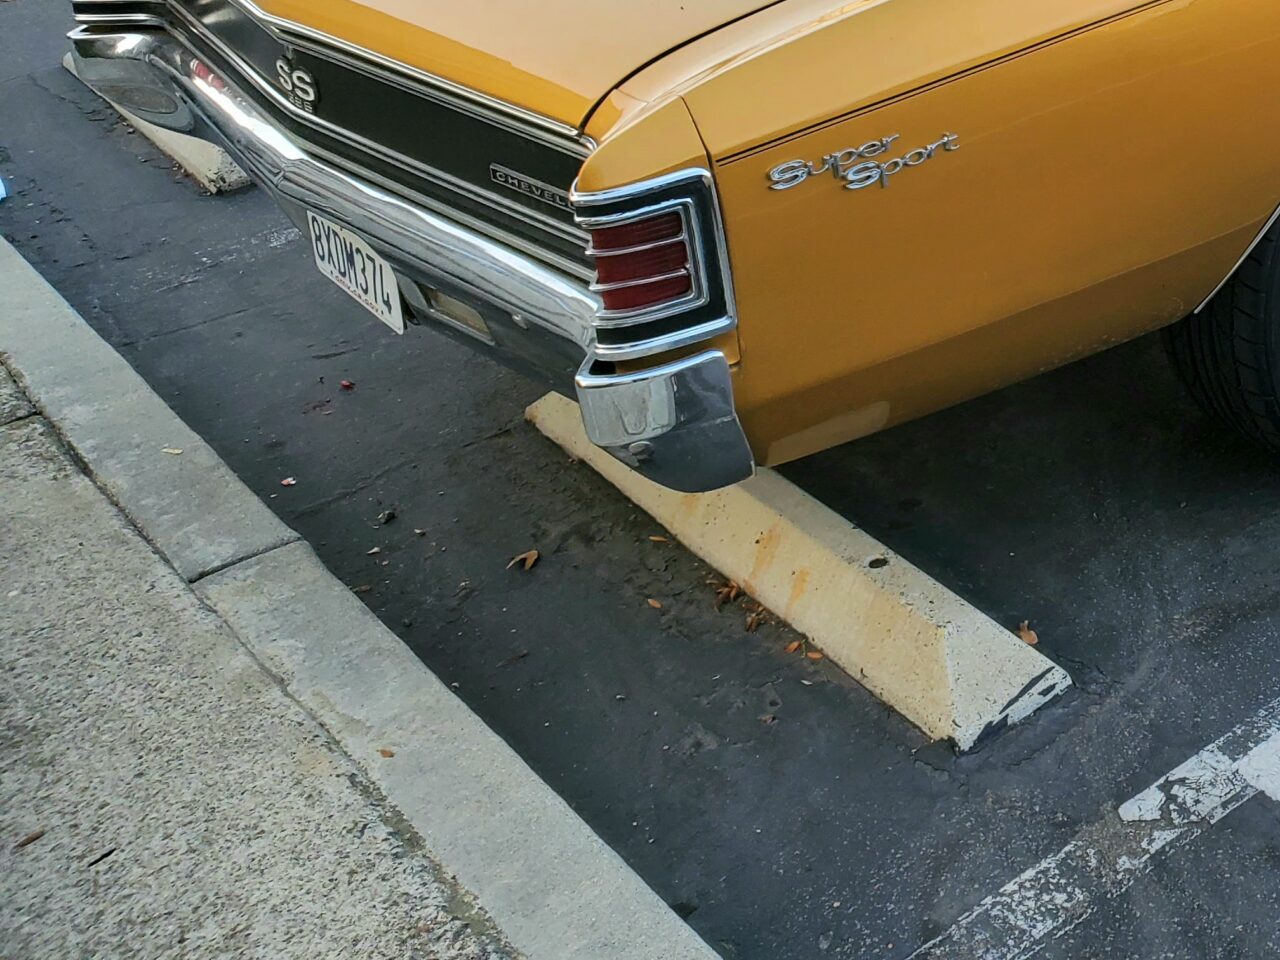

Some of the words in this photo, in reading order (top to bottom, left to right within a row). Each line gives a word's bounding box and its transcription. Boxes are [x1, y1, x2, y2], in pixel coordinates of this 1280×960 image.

[275, 58, 316, 102] SS
[768, 133, 900, 190] Super
[843, 131, 961, 190] Sport
[311, 214, 393, 315] 8XDM374
